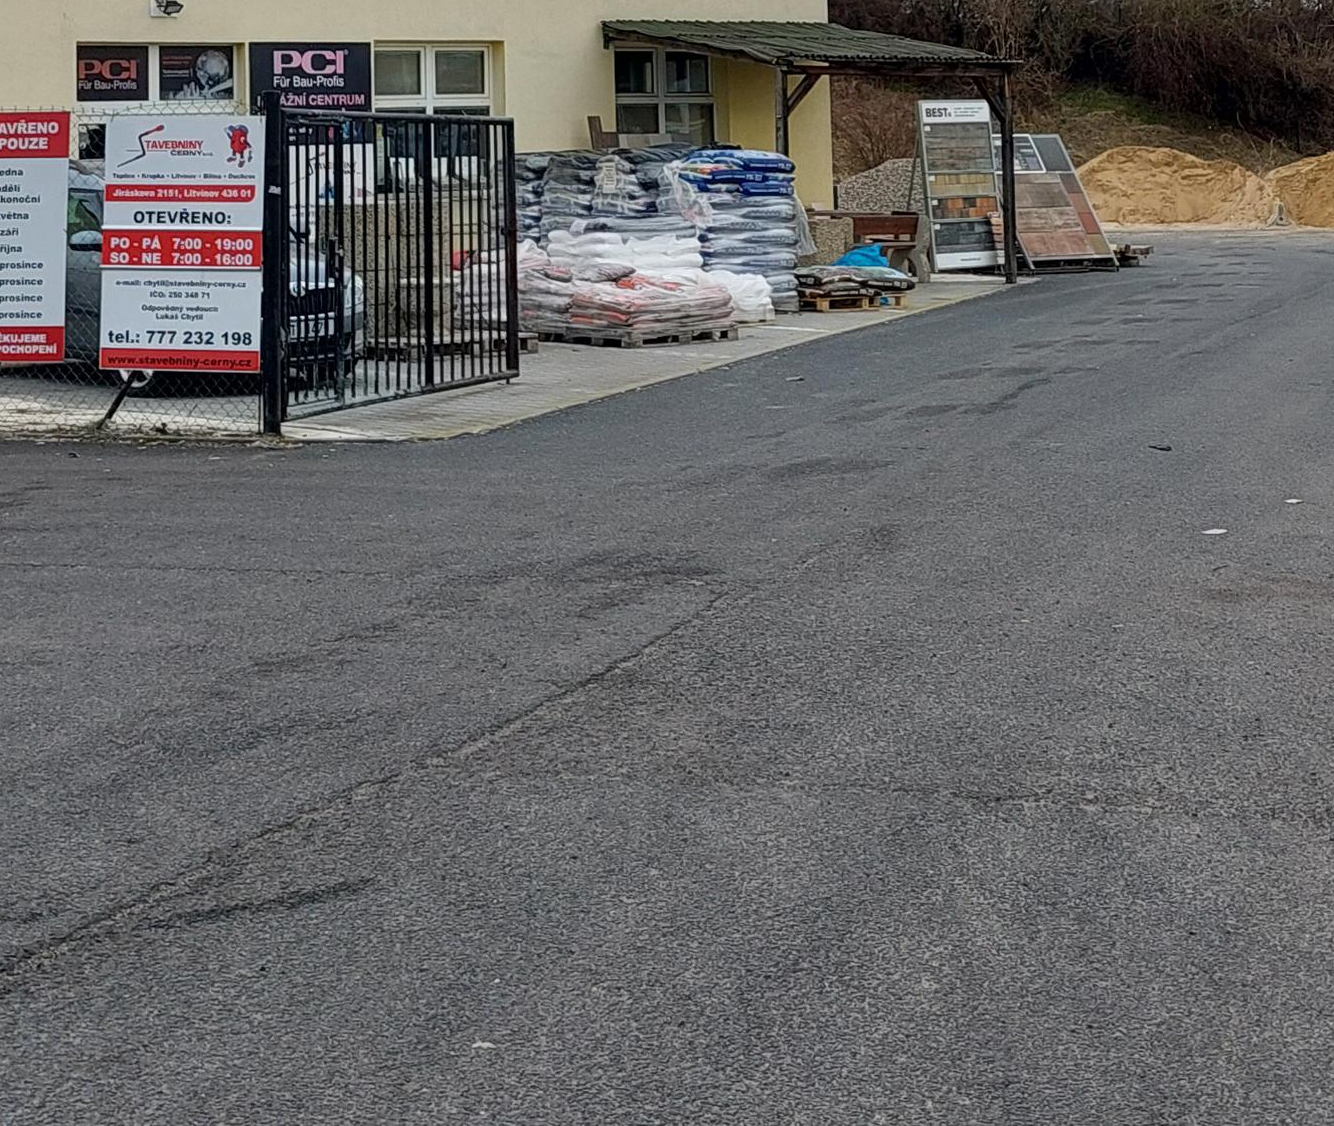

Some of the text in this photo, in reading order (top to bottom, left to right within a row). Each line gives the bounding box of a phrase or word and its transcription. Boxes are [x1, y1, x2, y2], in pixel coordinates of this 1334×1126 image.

[273, 50, 344, 75] PCI
[79, 60, 137, 80] PCI
[78, 80, 137, 90] Für Bau-Profis
[273, 75, 345, 87] Für Bau-Profis
[308, 95, 365, 106] CENTRUM
[240, 189, 252, 198] 01
[133, 208, 232, 225] OTEVŘENO:
[0, 227, 19, 236] září
[110, 237, 130, 249] PO
[142, 235, 162, 249] PÁ
[172, 237, 202, 250] 7:00
[215, 238, 253, 250] 19:00
[0, 244, 23, 254] října
[109, 252, 130, 264] SO
[141, 253, 162, 264] NE
[171, 253, 202, 265] 7:00
[215, 253, 253, 266] 16:00
[0, 261, 44, 271] prosince
[180, 313, 204, 321] Chytil
[108, 330, 253, 346] tel.: 777 232 198
[107, 354, 253, 369] www.stavebniny-cerny.cz
